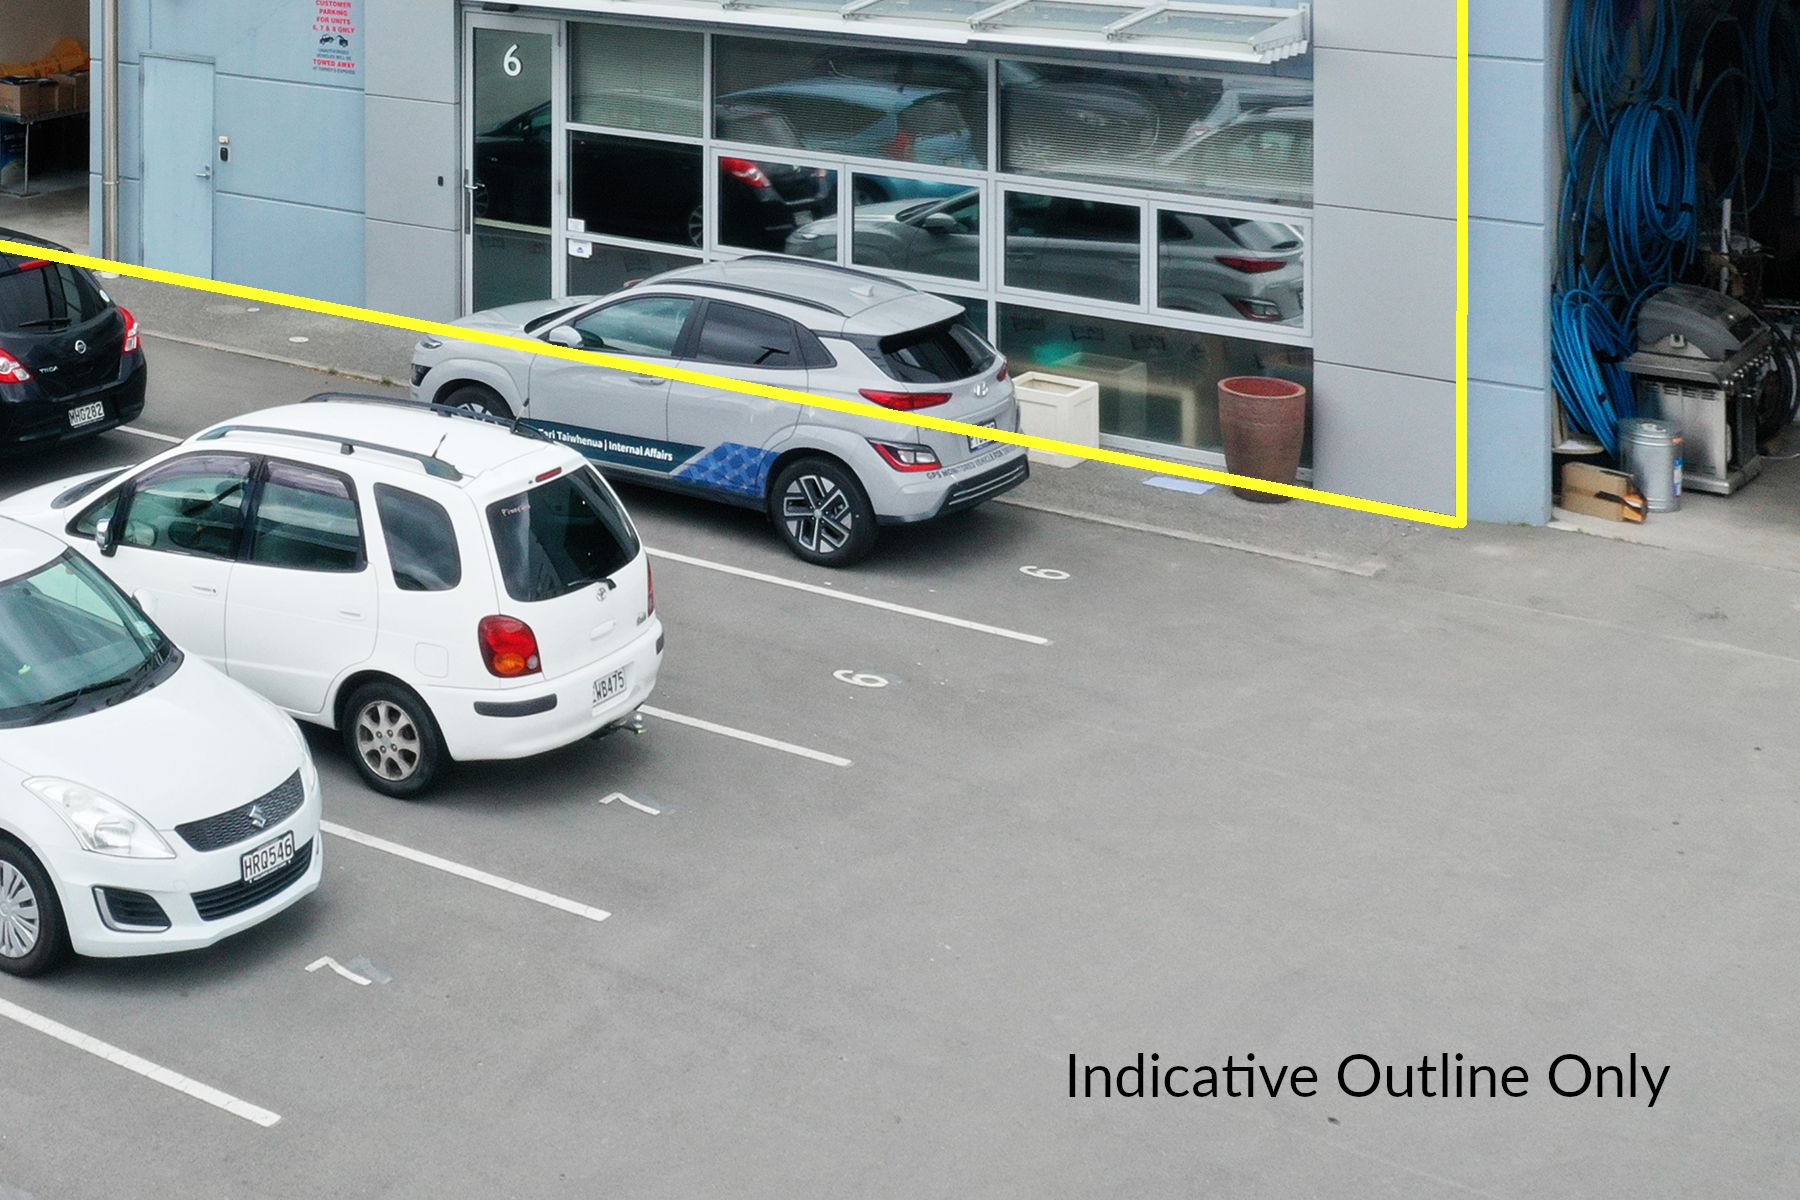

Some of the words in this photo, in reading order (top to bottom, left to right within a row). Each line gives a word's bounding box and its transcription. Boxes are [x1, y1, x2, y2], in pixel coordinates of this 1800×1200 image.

[315, 0, 351, 8] CUSTOMER
[313, 59, 336, 67] TOWED
[503, 44, 521, 76] 6
[68, 402, 103, 425] MHG282
[557, 431, 603, 448] Taiwhenua
[609, 441, 643, 456] Internal
[644, 448, 673, 462] Affairs
[1018, 565, 1071, 581] 6
[832, 669, 889, 689] 6
[244, 838, 292, 879] HRQ546
